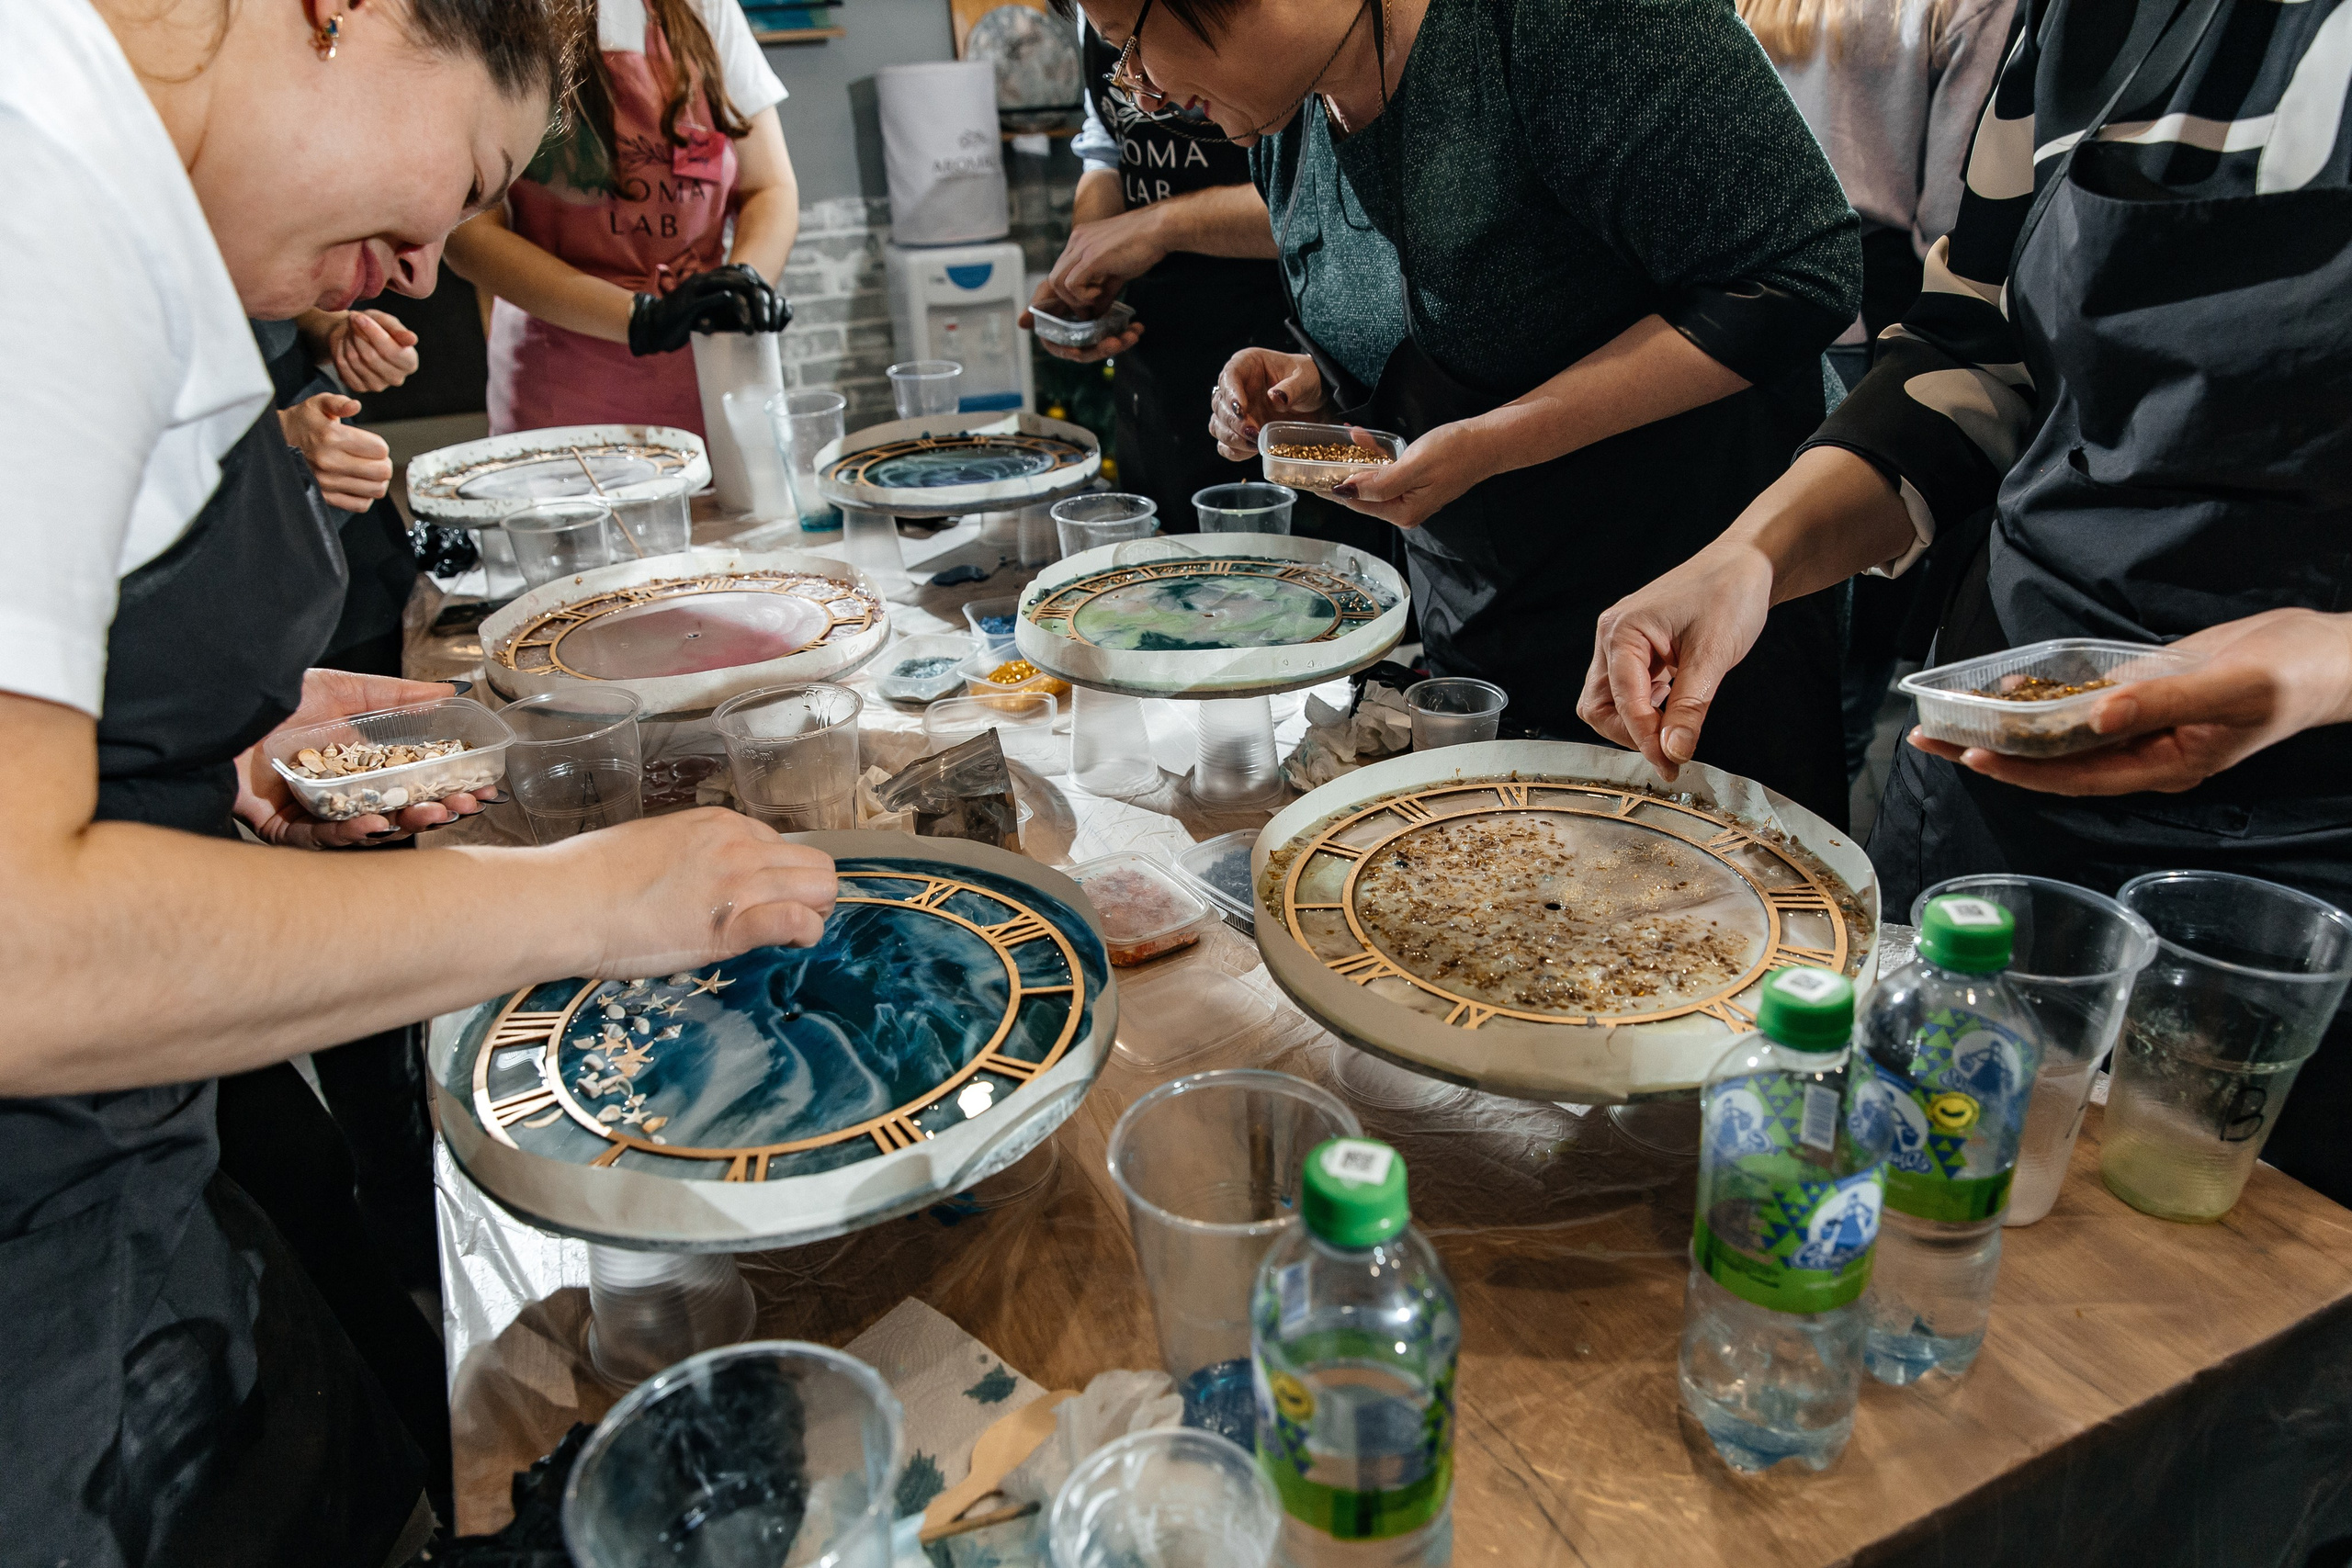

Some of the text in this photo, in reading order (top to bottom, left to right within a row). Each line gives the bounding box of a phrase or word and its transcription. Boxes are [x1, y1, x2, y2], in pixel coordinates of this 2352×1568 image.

[1121, 139, 1209, 168] OMA
[608, 178, 707, 203] OMA
[610, 211, 678, 239] LAB
